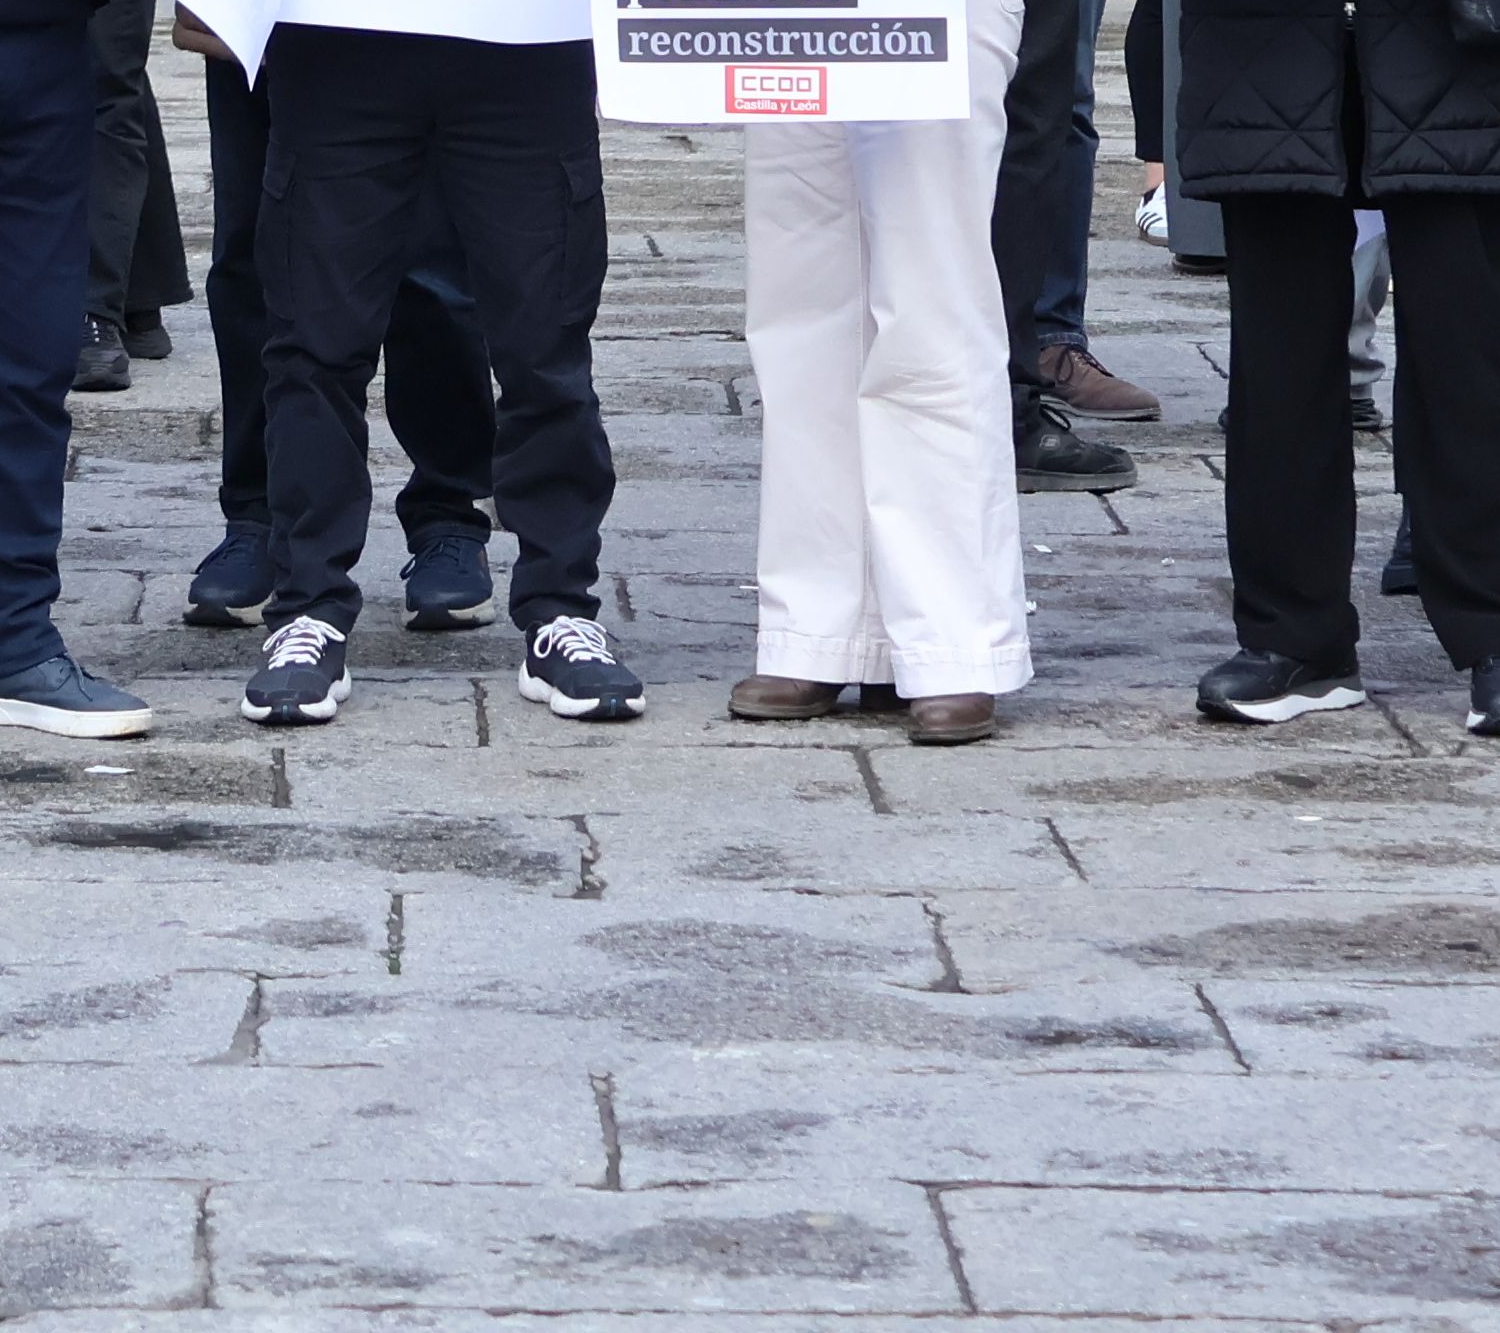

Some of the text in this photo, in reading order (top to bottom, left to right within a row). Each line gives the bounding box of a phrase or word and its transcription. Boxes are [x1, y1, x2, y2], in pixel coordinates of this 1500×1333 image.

[627, 22, 935, 57] reconstrucción
[741, 76, 811, 92] CCOO
[734, 99, 820, 112] Castilla y León
